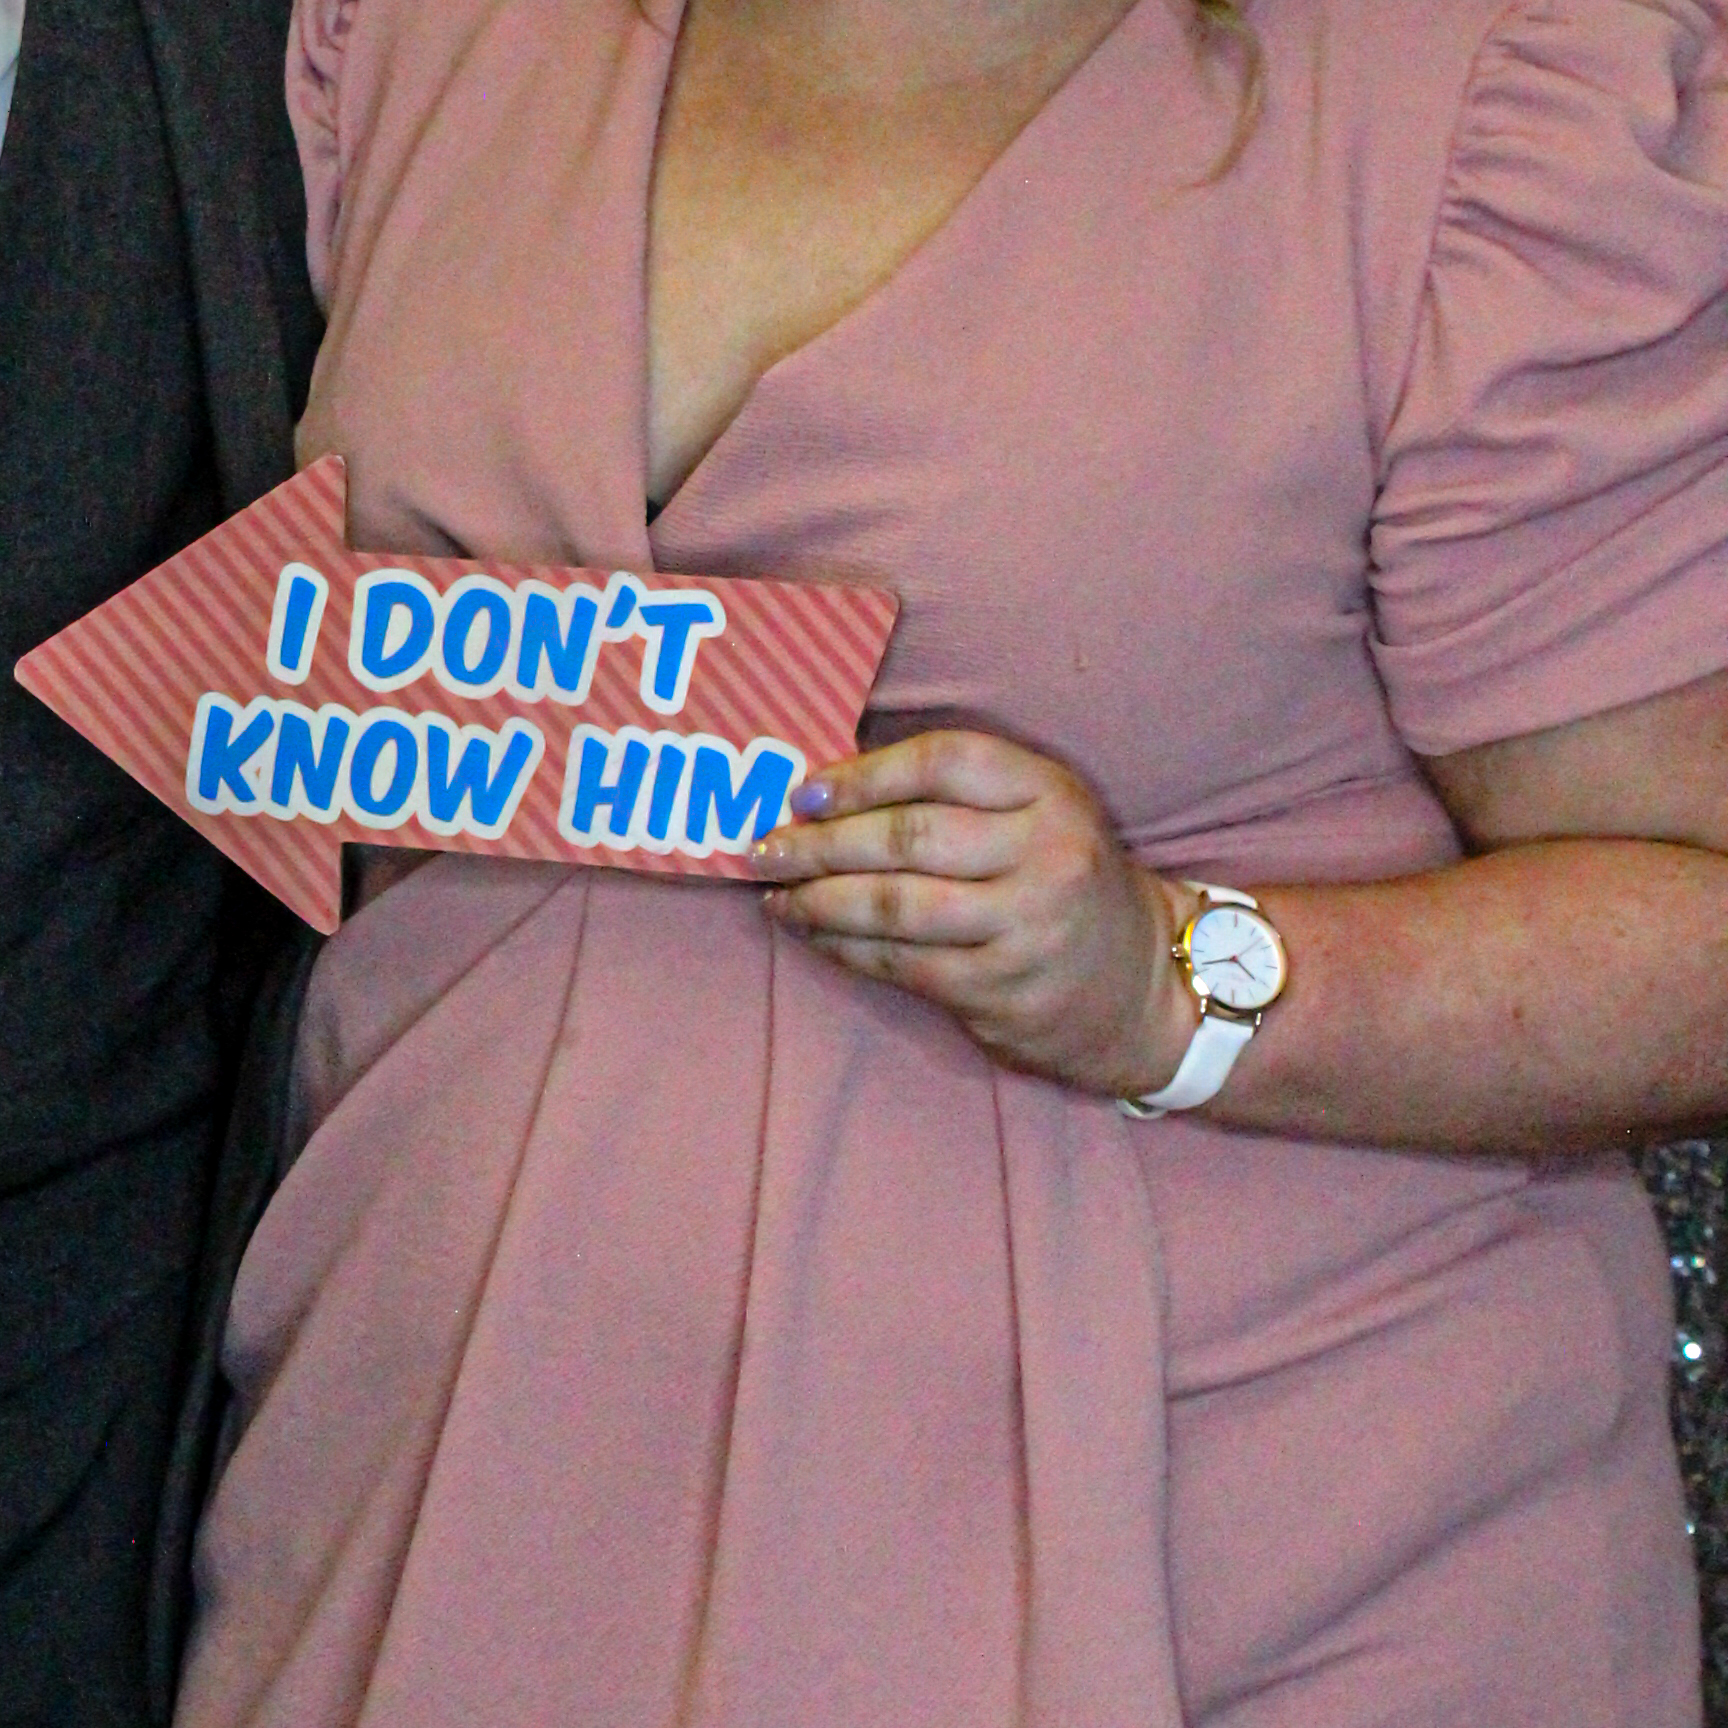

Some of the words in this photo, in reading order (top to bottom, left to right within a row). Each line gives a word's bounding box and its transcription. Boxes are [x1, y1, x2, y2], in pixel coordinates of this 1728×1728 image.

[275, 571, 321, 676] I
[357, 577, 718, 706] DON'T
[194, 701, 538, 831] KNOW
[567, 731, 798, 849] HIM
